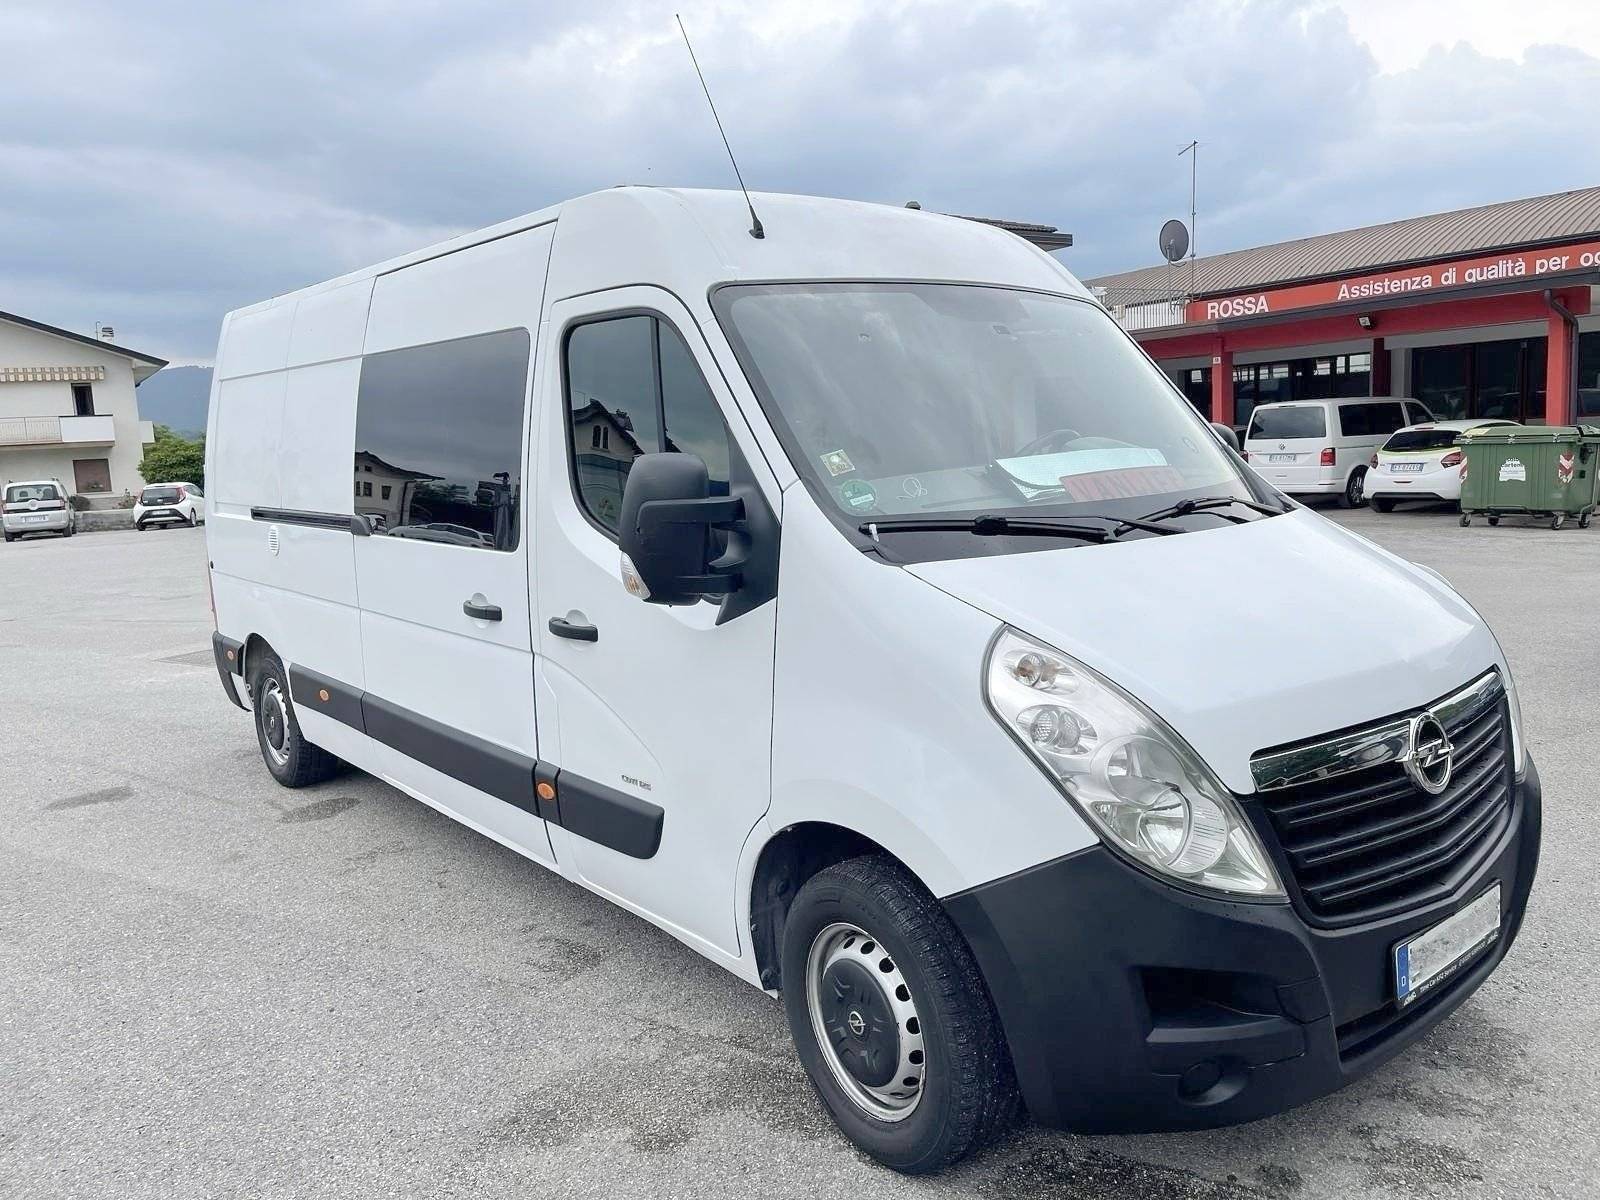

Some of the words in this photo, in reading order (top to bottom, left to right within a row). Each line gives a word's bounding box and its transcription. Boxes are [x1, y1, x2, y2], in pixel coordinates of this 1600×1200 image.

[1337, 274, 1432, 300] Assistenza
[1441, 267, 1457, 285] di
[1464, 258, 1526, 283] qualità
[1535, 255, 1570, 275] per
[1207, 295, 1270, 320] ROSSA
